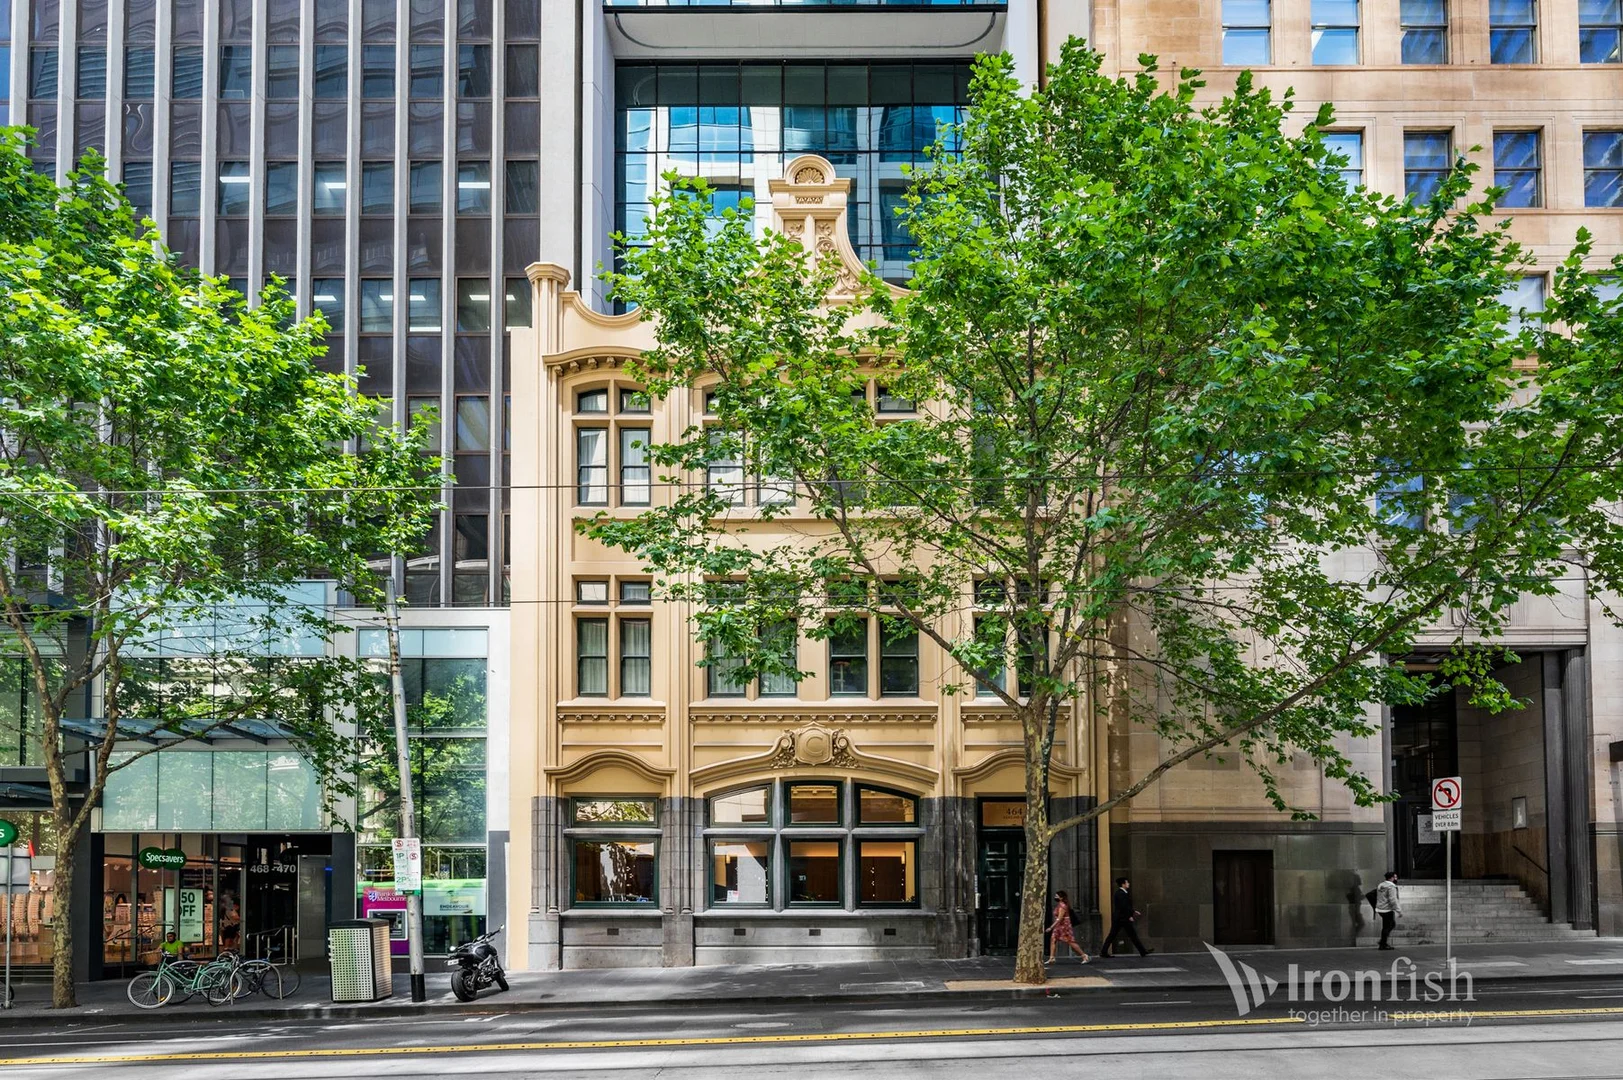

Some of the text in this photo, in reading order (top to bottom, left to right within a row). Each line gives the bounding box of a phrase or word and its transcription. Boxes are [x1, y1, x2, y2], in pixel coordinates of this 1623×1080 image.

[146, 852, 184, 864] Specsavers
[250, 864, 270, 873] 468
[276, 864, 297, 873] 470
